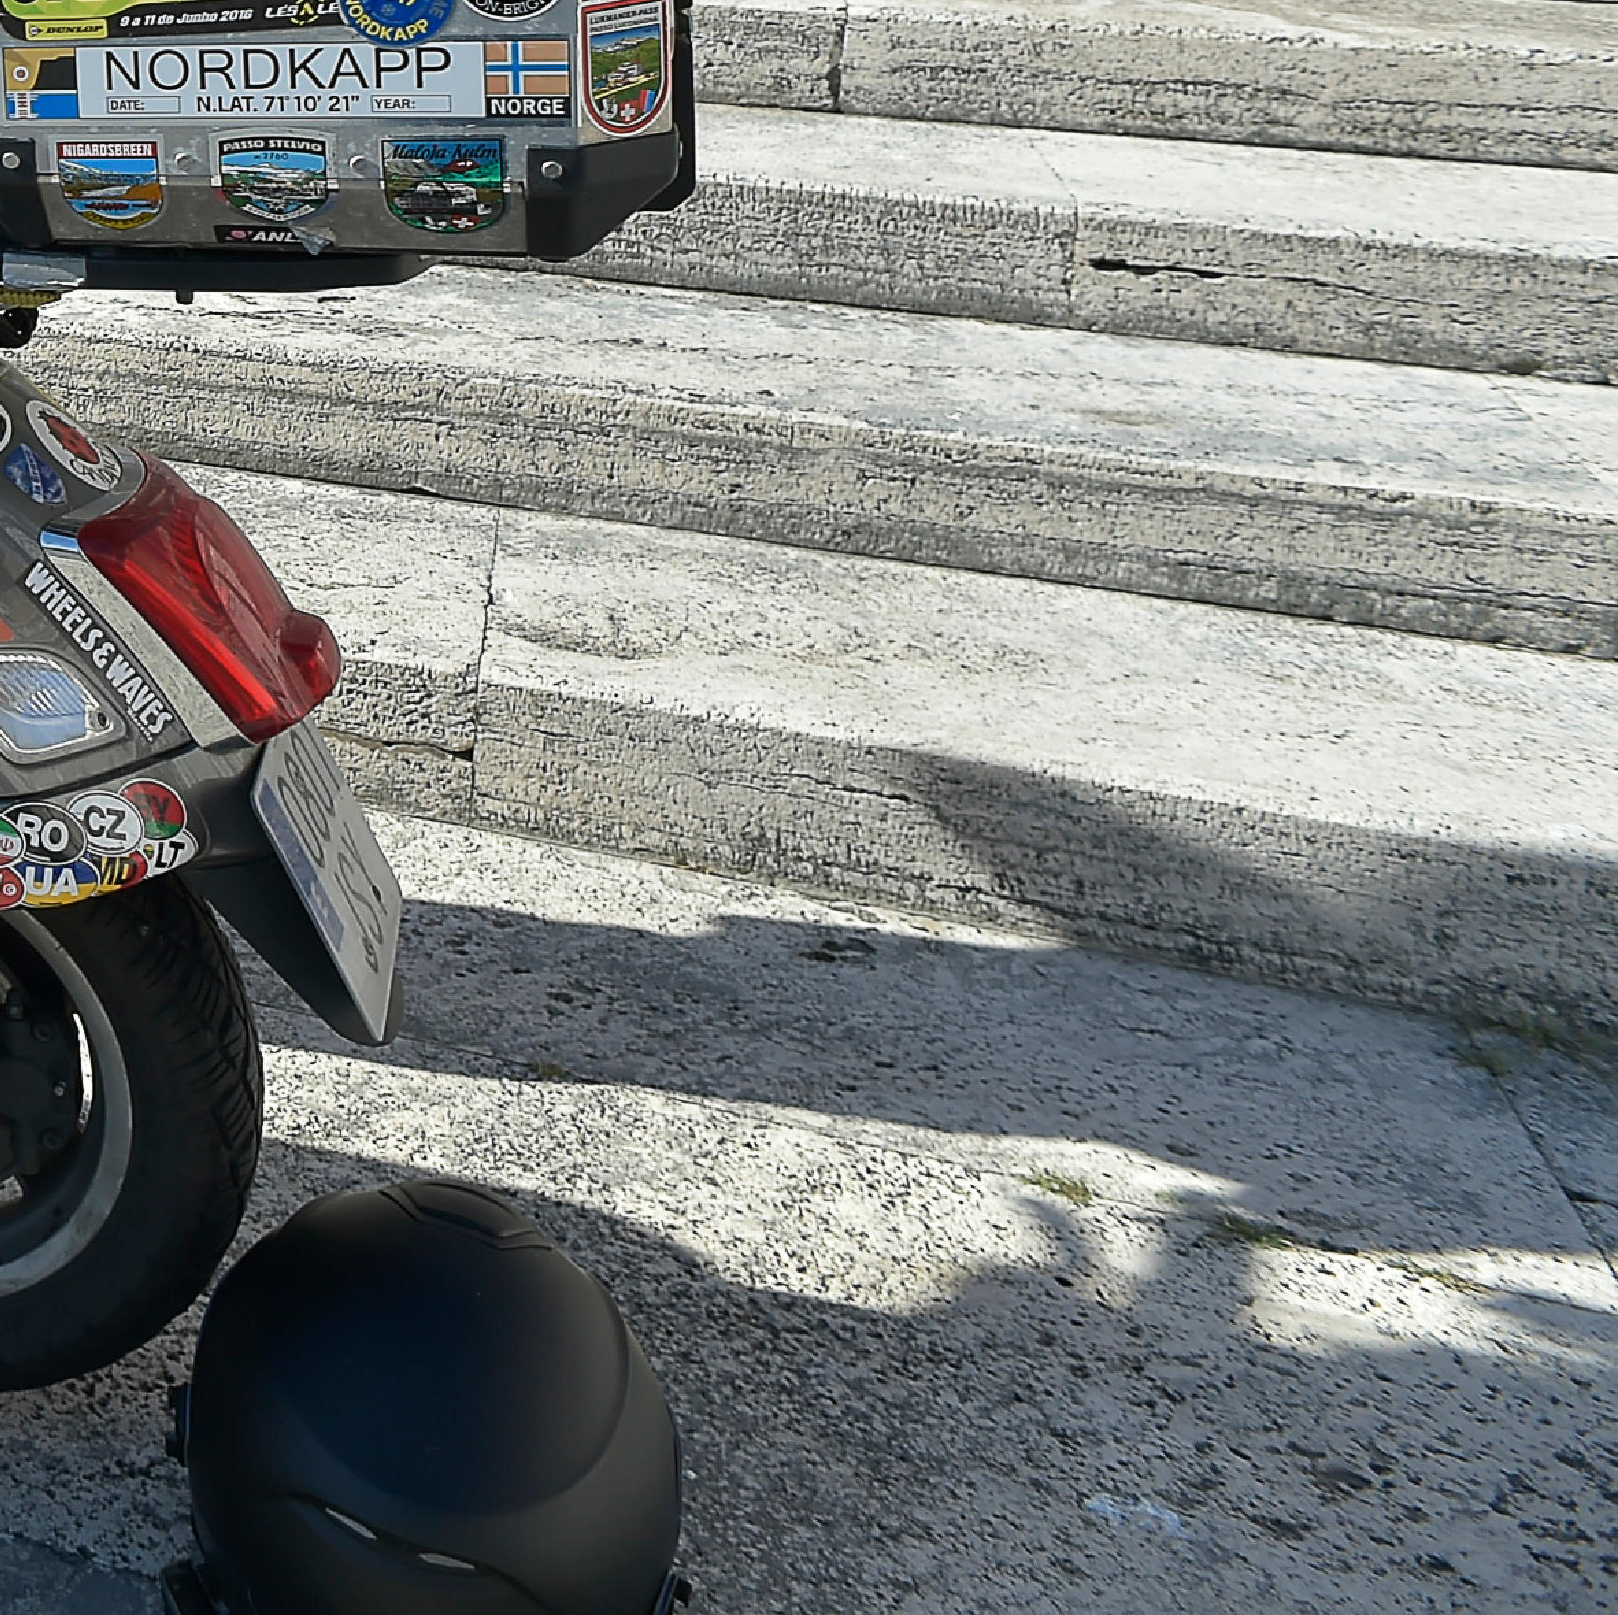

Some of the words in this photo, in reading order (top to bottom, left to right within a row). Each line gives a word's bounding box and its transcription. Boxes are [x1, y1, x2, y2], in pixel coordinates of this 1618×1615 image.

[176, 11, 218, 24] Junho
[105, 46, 453, 92] NORDKAPP
[109, 98, 147, 112] DATE:
[196, 95, 260, 113] N.LAT.
[373, 97, 417, 111] YEAR:
[490, 96, 566, 115] NORGE
[62, 143, 154, 158] NIGARDSBREEN
[222, 140, 264, 153] PASSO
[268, 139, 324, 153] STELVIO
[17, 812, 69, 851] RO
[82, 805, 128, 842] CZ
[24, 865, 80, 898] UA
